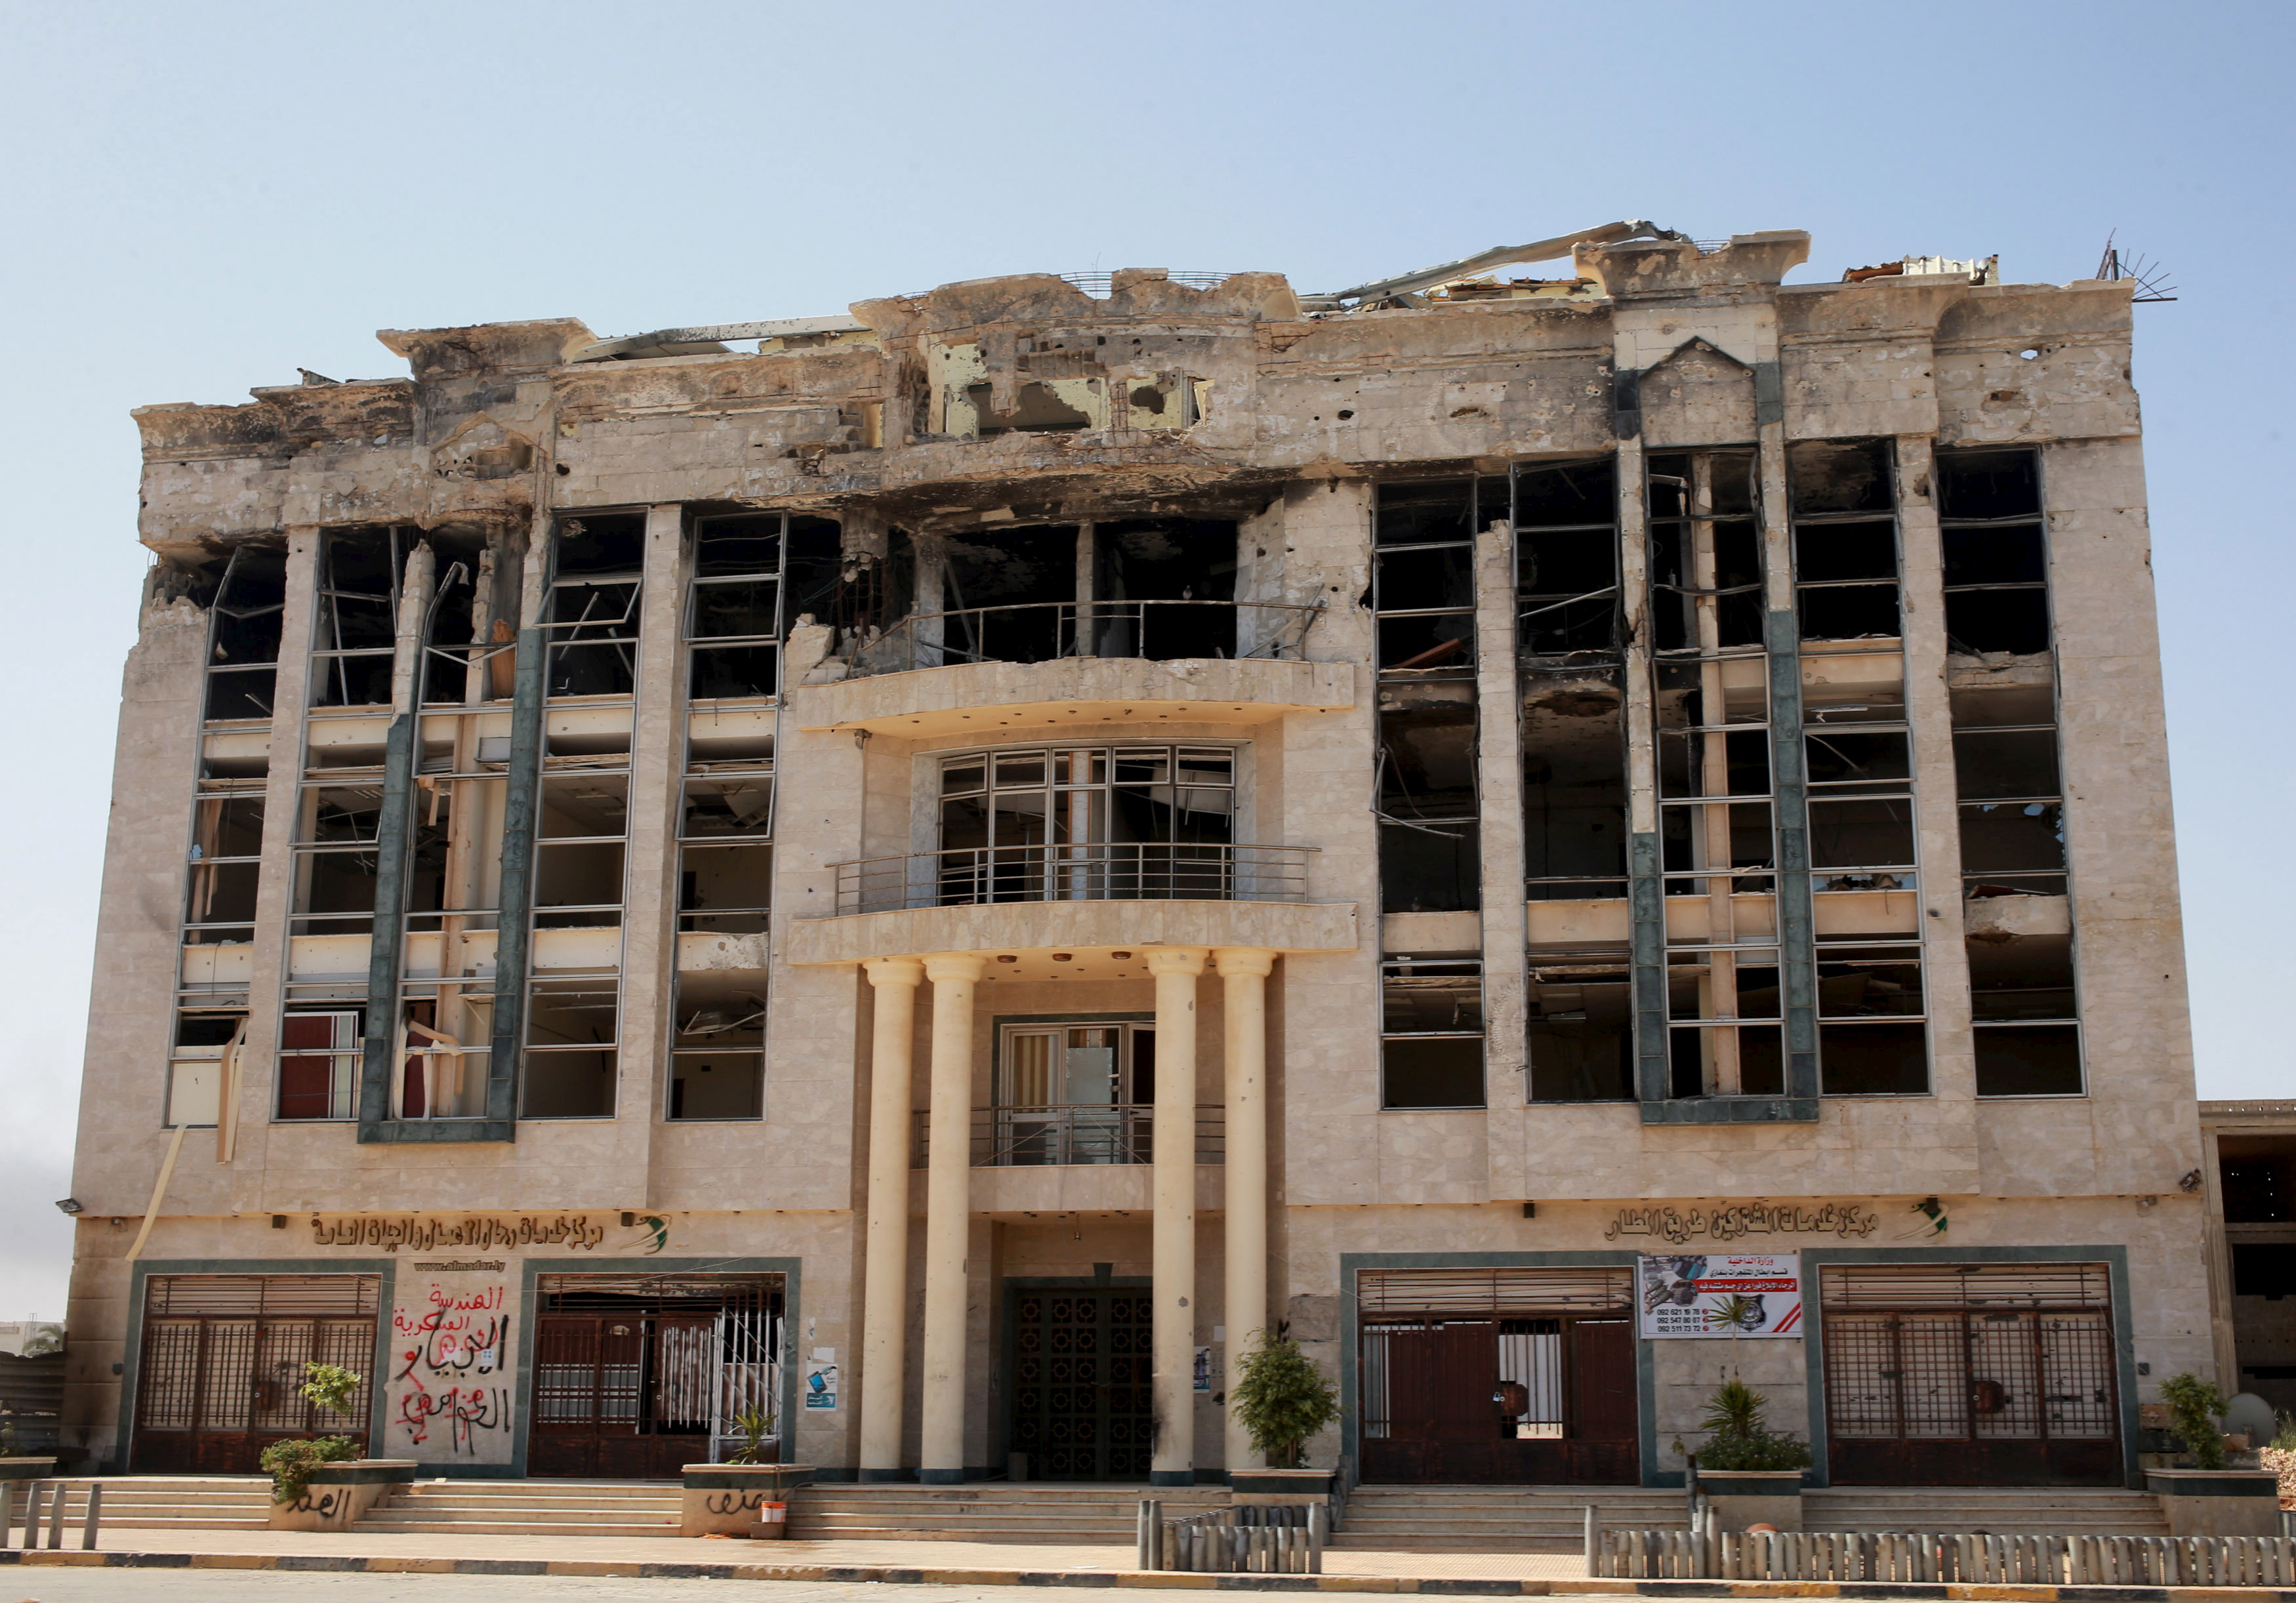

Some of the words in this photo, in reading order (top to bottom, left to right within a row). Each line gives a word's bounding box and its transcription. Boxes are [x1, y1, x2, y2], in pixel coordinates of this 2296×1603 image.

[1605, 1207, 1661, 1242] المطار
[1662, 1207, 1706, 1245] طريق
[1711, 1202, 1778, 1241] المشتركين
[1778, 1203, 1839, 1232] خدمات
[1837, 1206, 1879, 1239] مركز
[414, 1260, 506, 1272] www.almadar.ly
[1727, 1257, 1757, 1267] الداخلية
[1757, 1256, 1774, 1265] وزارة
[428, 1283, 504, 1310] الهندسة
